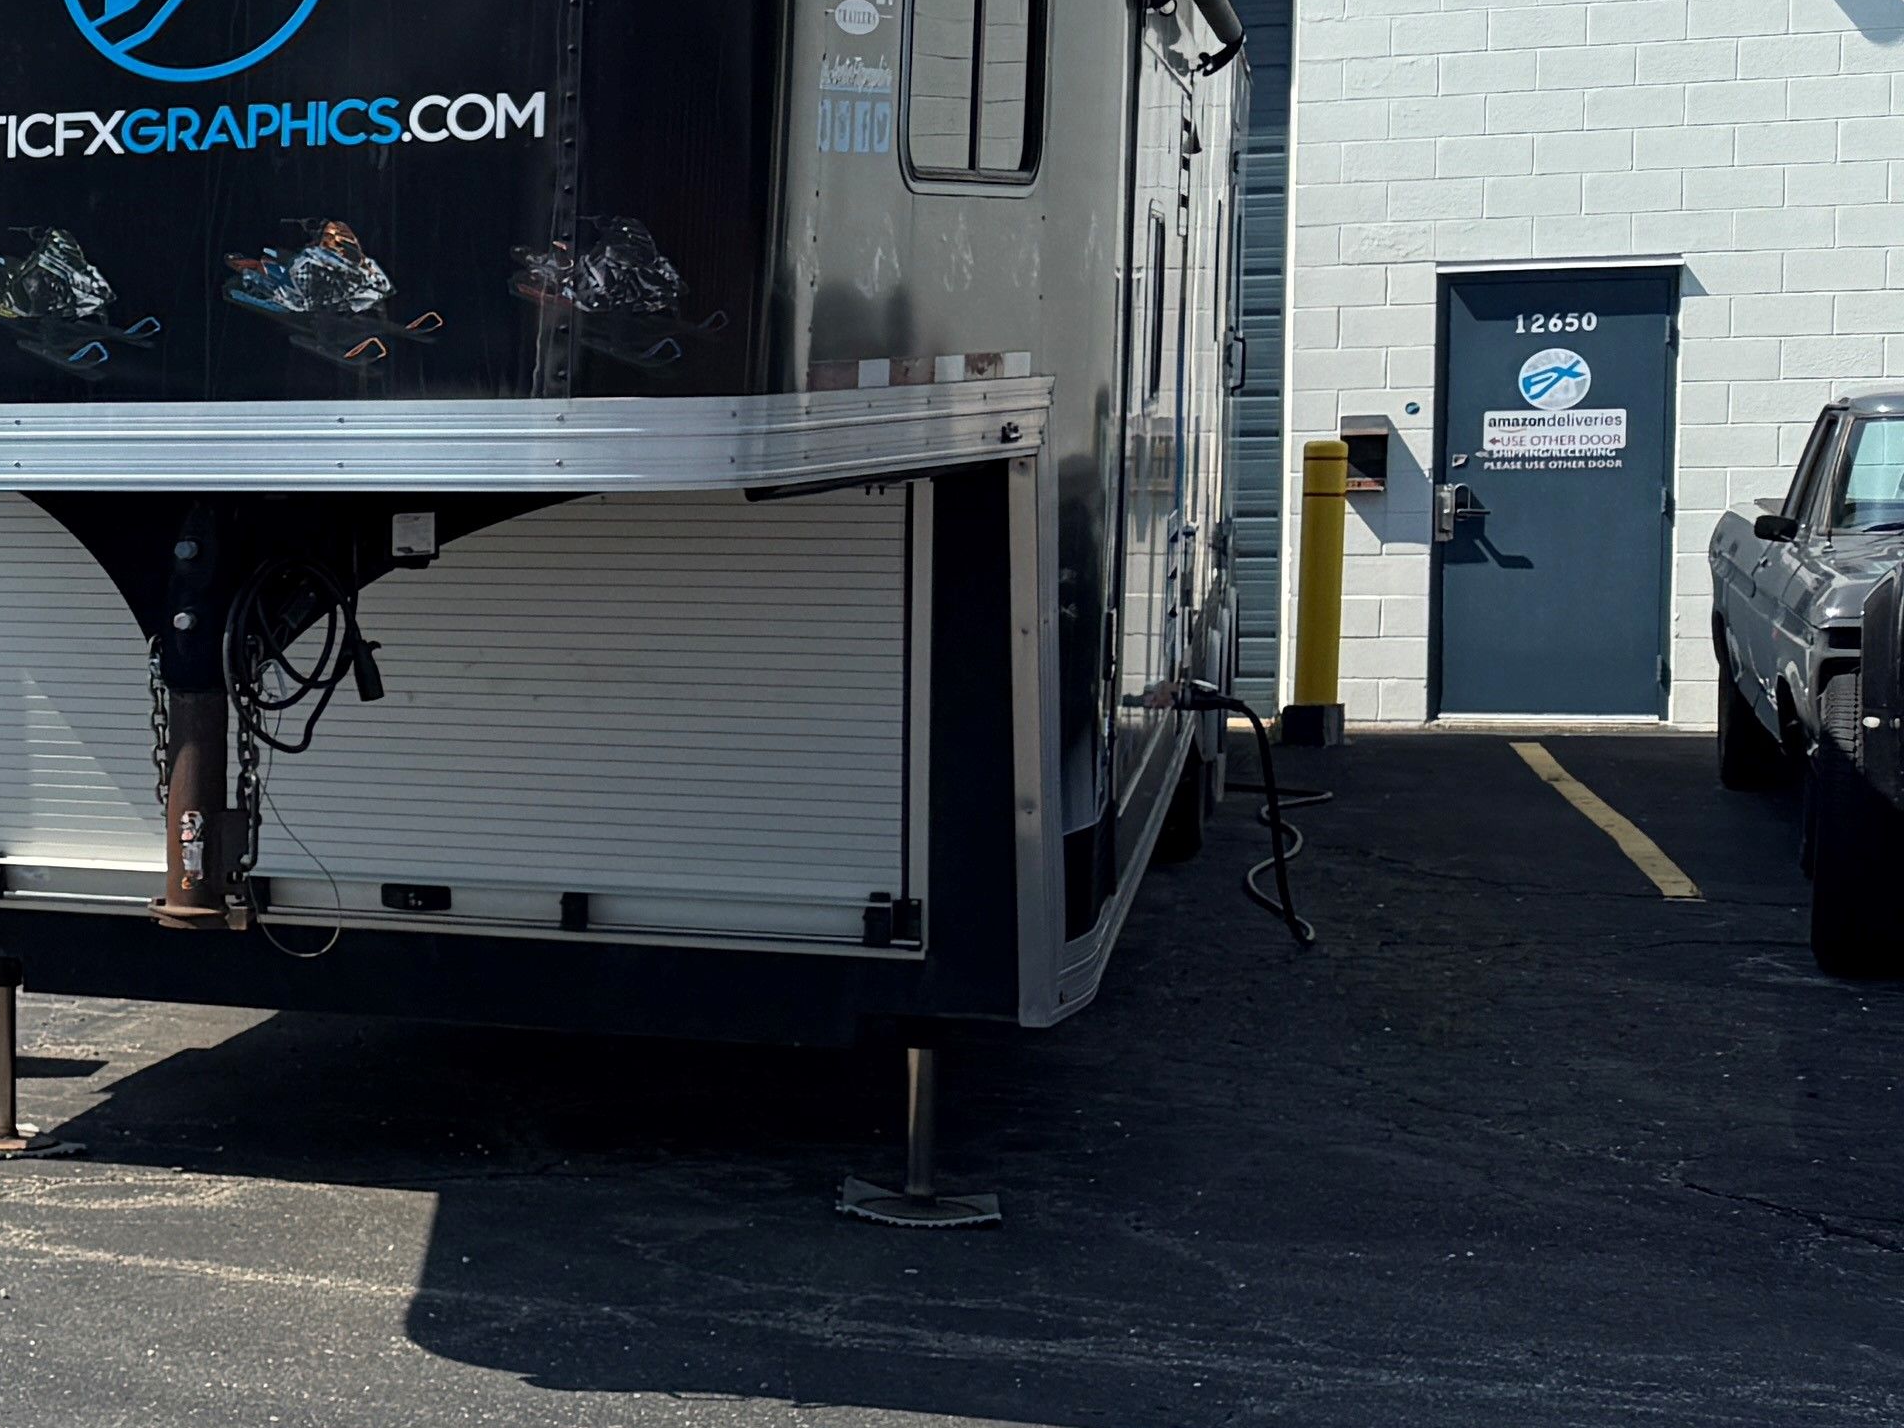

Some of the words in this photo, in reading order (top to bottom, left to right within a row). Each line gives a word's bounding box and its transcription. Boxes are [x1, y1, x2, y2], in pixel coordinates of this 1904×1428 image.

[1515, 311, 1598, 334] 12650
[1501, 436, 1526, 447] USE
[1530, 435, 1576, 446] OTHER
[1579, 434, 1621, 445] DOOR
[1484, 461, 1522, 470] PLEASE
[1525, 461, 1545, 469] USE
[1548, 461, 1585, 469] OTHER
[1588, 460, 1622, 468] DOOR
